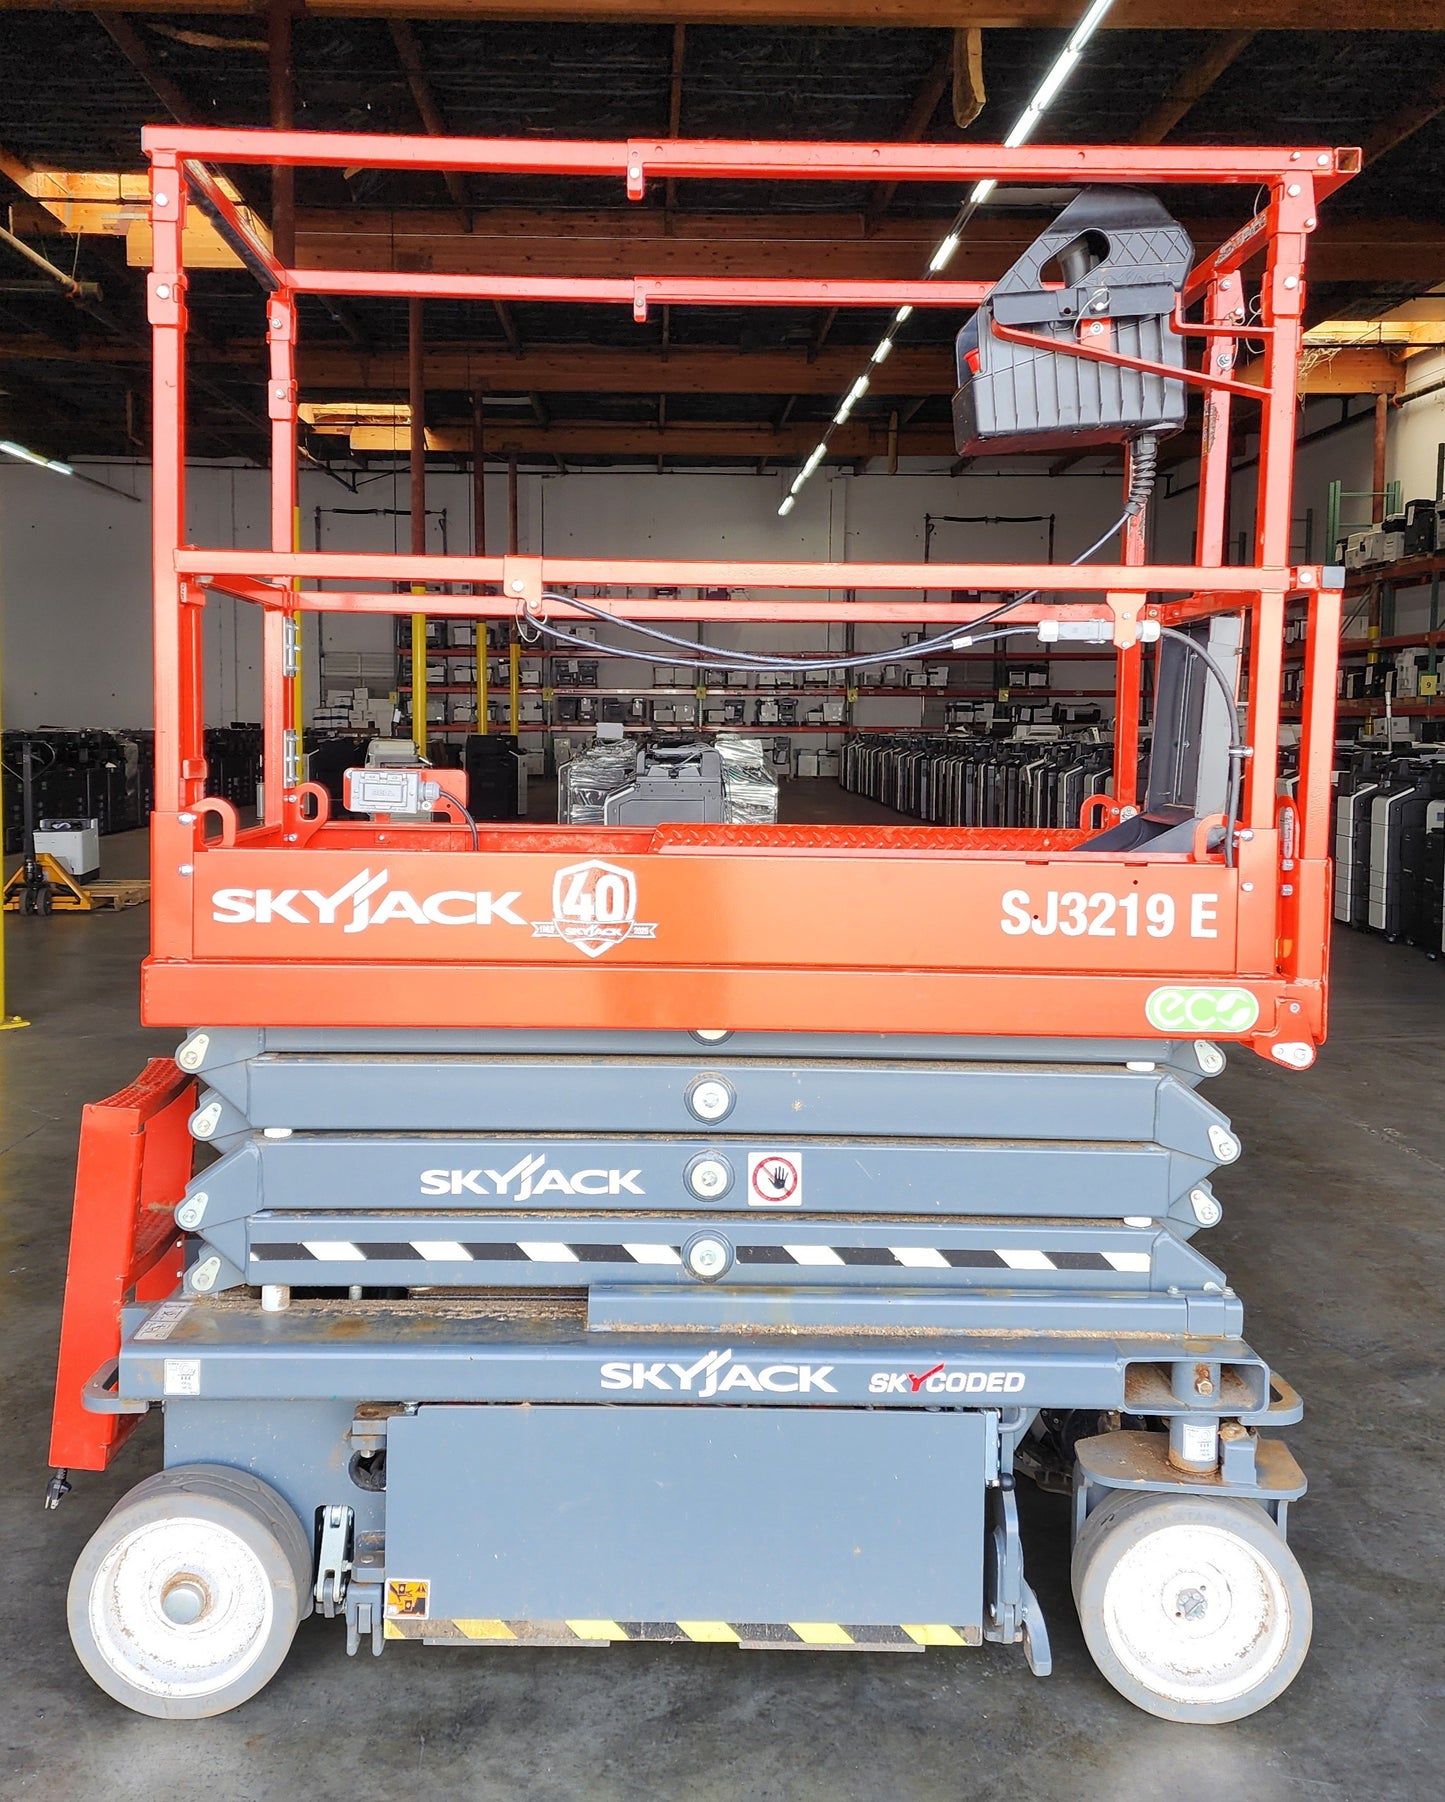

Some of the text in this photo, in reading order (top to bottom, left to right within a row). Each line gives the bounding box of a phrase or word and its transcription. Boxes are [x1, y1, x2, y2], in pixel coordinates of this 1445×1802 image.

[211, 867, 529, 934] SKYJACK
[561, 869, 625, 922] 40
[1000, 889, 1219, 938] SJ3219 E
[564, 924, 623, 937] SKYJACK
[1153, 991, 1251, 1026] eco
[420, 1152, 646, 1202] SKYJACK
[599, 1348, 840, 1398] SKYJACK
[868, 1361, 1027, 1394] SKYCODED
